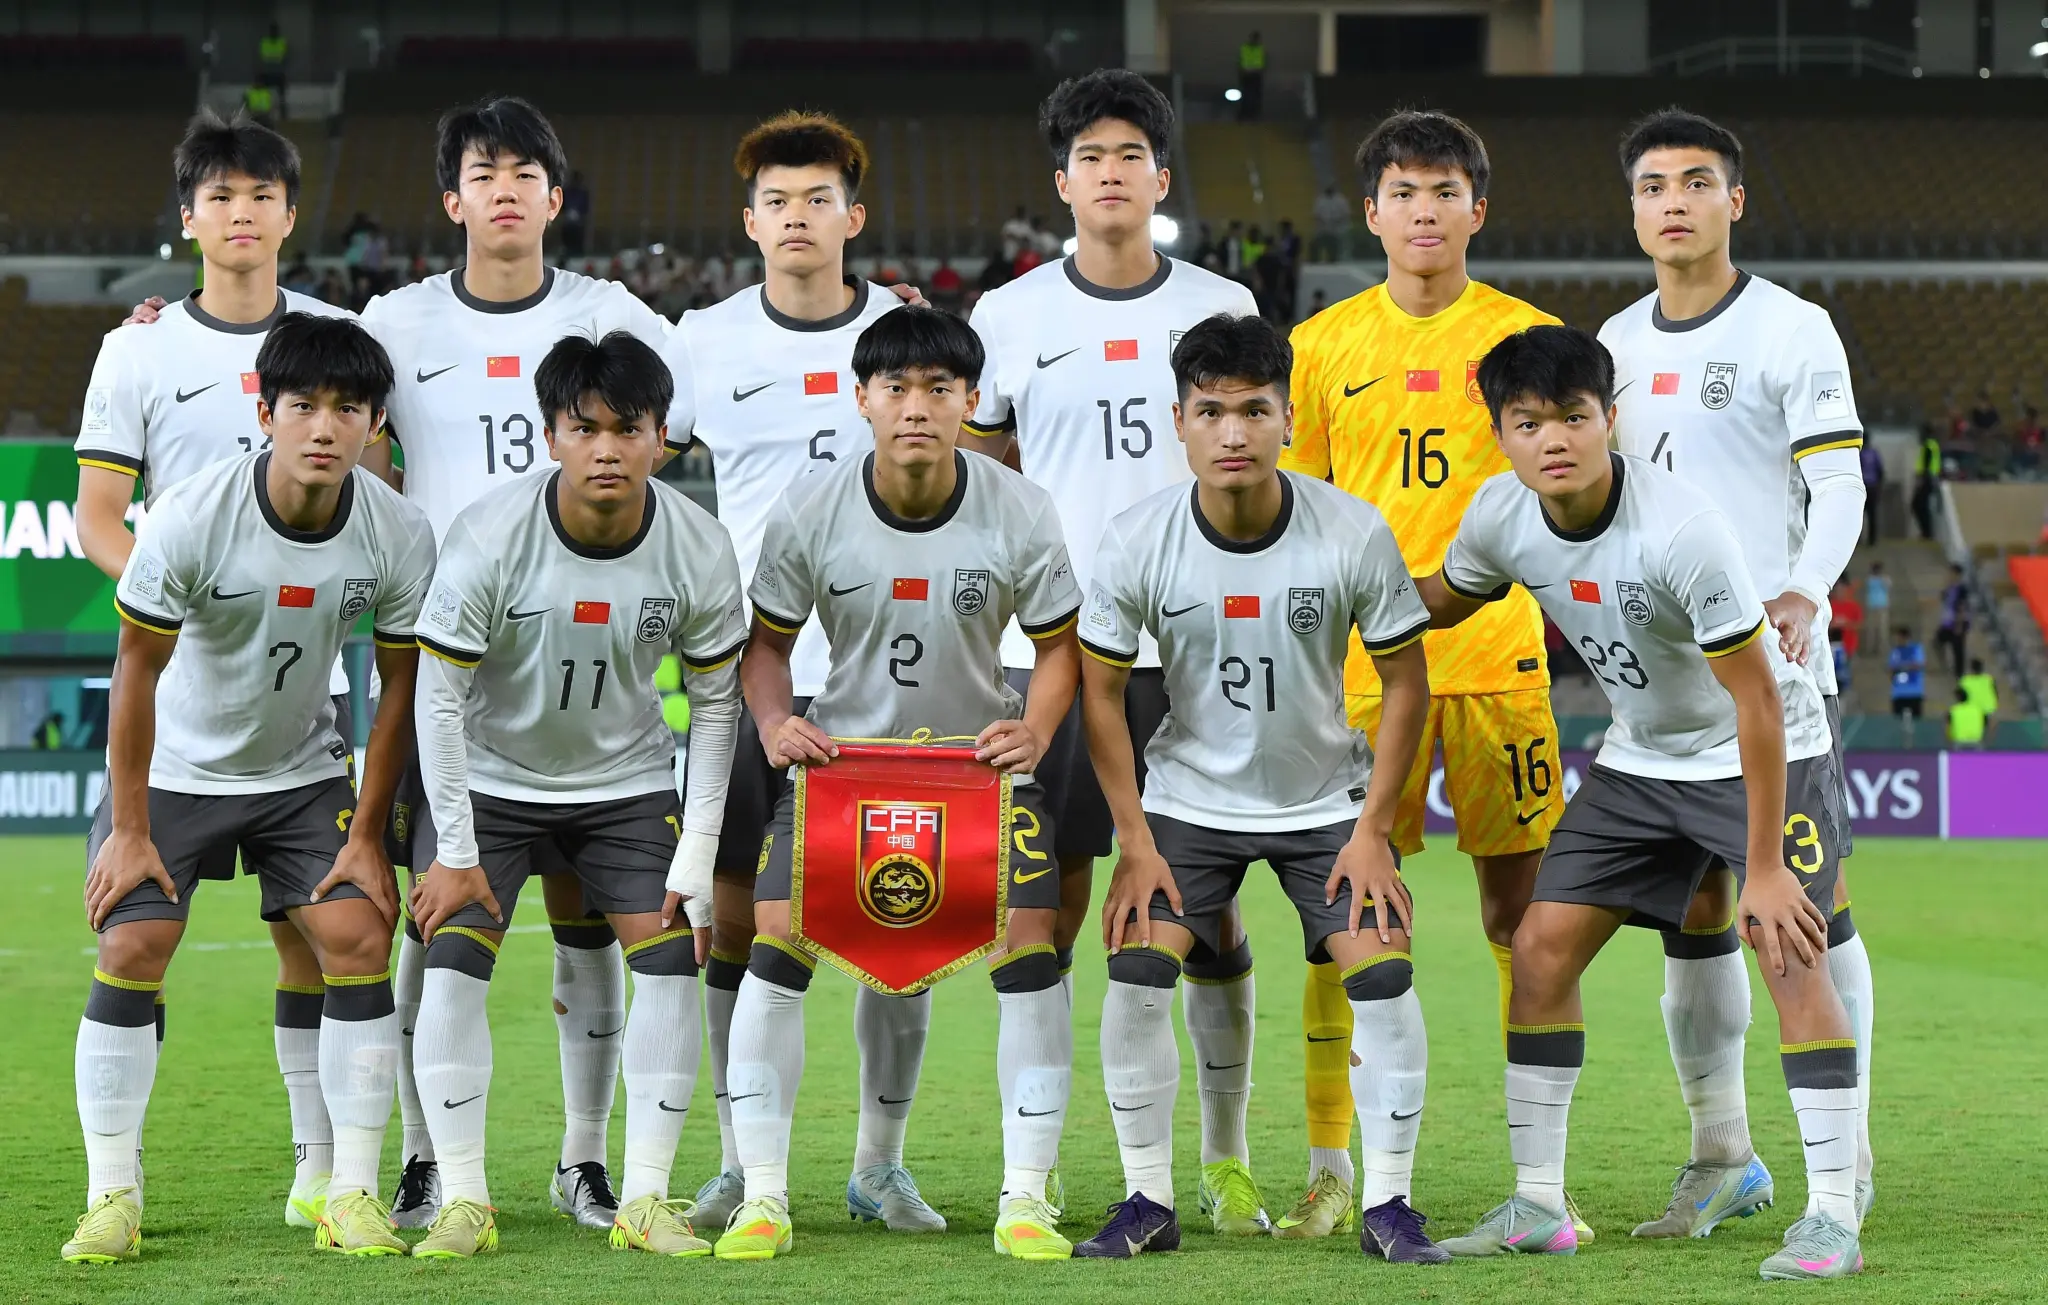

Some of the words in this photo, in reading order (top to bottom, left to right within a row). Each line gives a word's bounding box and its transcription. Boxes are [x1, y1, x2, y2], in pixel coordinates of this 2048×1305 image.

[1709, 366, 1734, 375] CFA
[1817, 388, 1841, 401] AFC
[479, 413, 534, 474] 13
[1097, 397, 1152, 460] 15
[1398, 427, 1449, 489] 16
[347, 582, 374, 590] CFA
[959, 572, 986, 581] CFA
[1052, 562, 1067, 584] AFC
[1619, 584, 1645, 594] CFA
[644, 601, 671, 610] CFA
[1292, 591, 1321, 600] CFA
[1702, 589, 1729, 610] AFC
[268, 641, 302, 691] 7
[889, 633, 924, 687] 2
[1580, 635, 1649, 690] 23
[560, 659, 607, 710] 11
[1219, 656, 1275, 711] 21
[1503, 737, 1551, 801] 16
[865, 809, 938, 834] CFA
[1011, 806, 1047, 861] 2
[887, 834, 915, 850] 中国
[1784, 813, 1824, 873] 3
